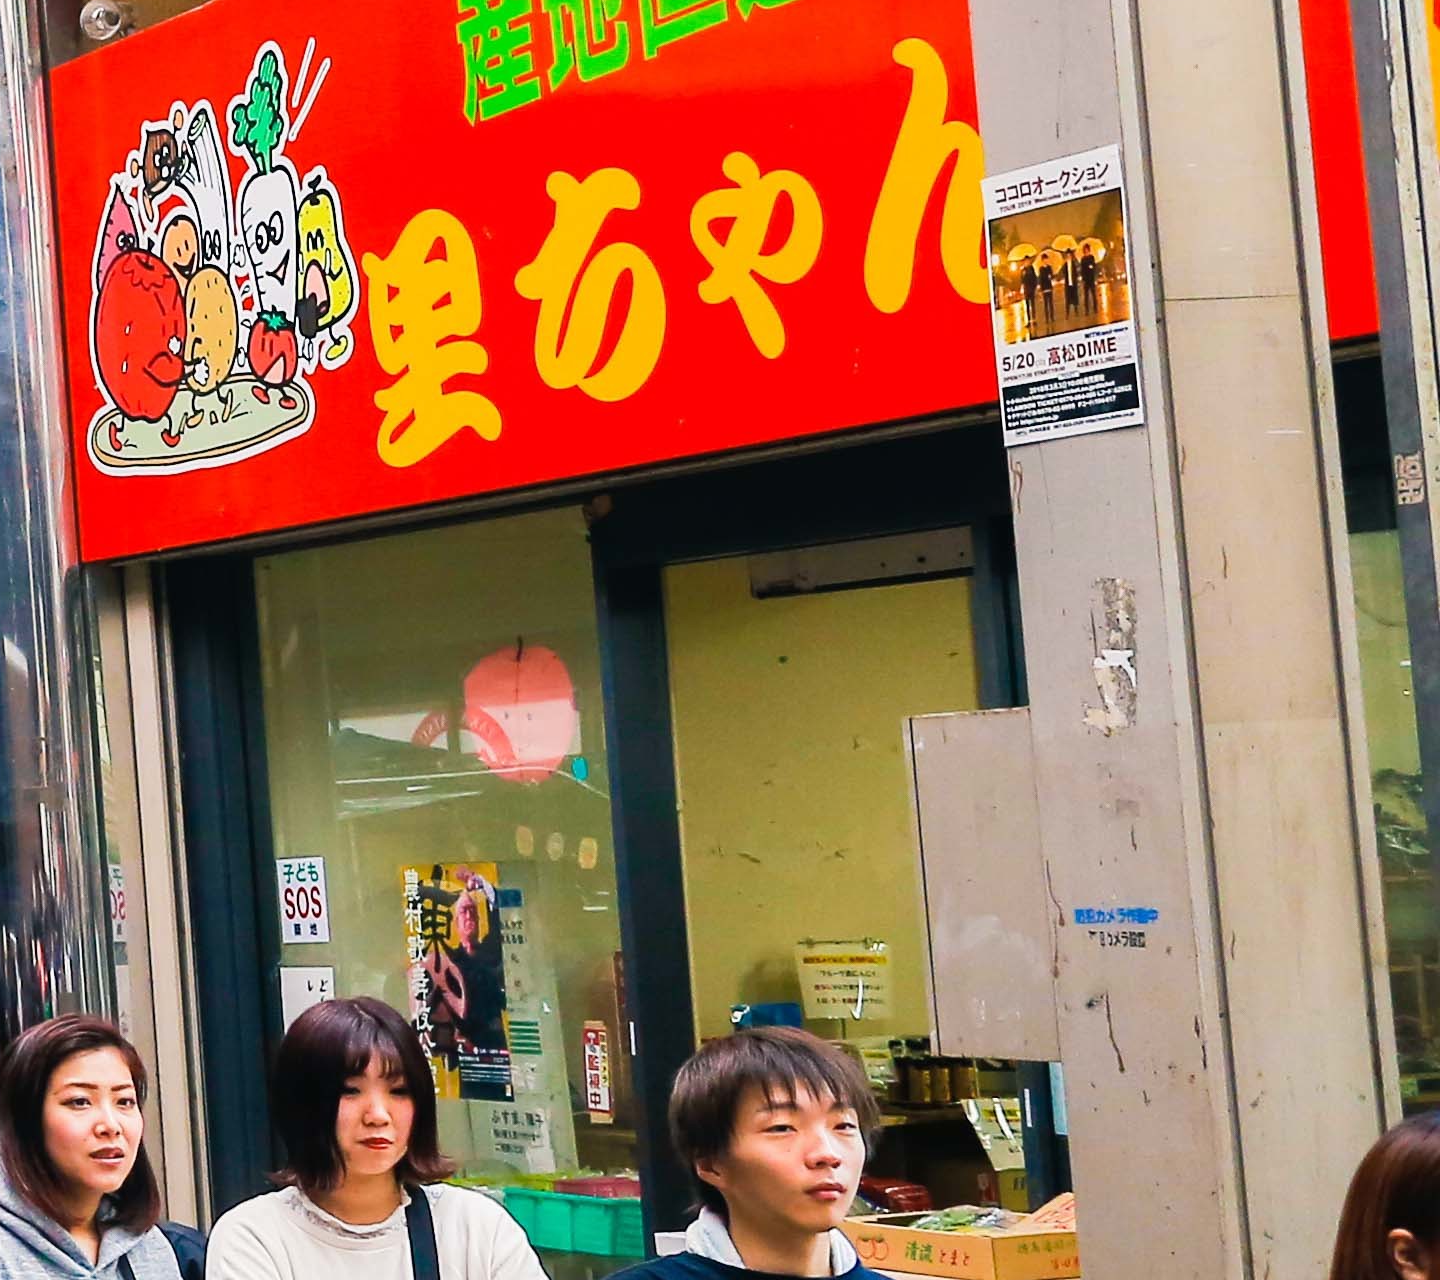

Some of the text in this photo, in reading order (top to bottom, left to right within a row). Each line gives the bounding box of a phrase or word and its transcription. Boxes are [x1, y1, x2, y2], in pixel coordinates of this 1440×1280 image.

[995, 162, 1109, 204] ココロオークション
[1002, 352, 1035, 371] 5/20
[1047, 337, 1117, 367] 高松DIME
[282, 862, 320, 884] 子ども
[284, 885, 323, 920] SOS
